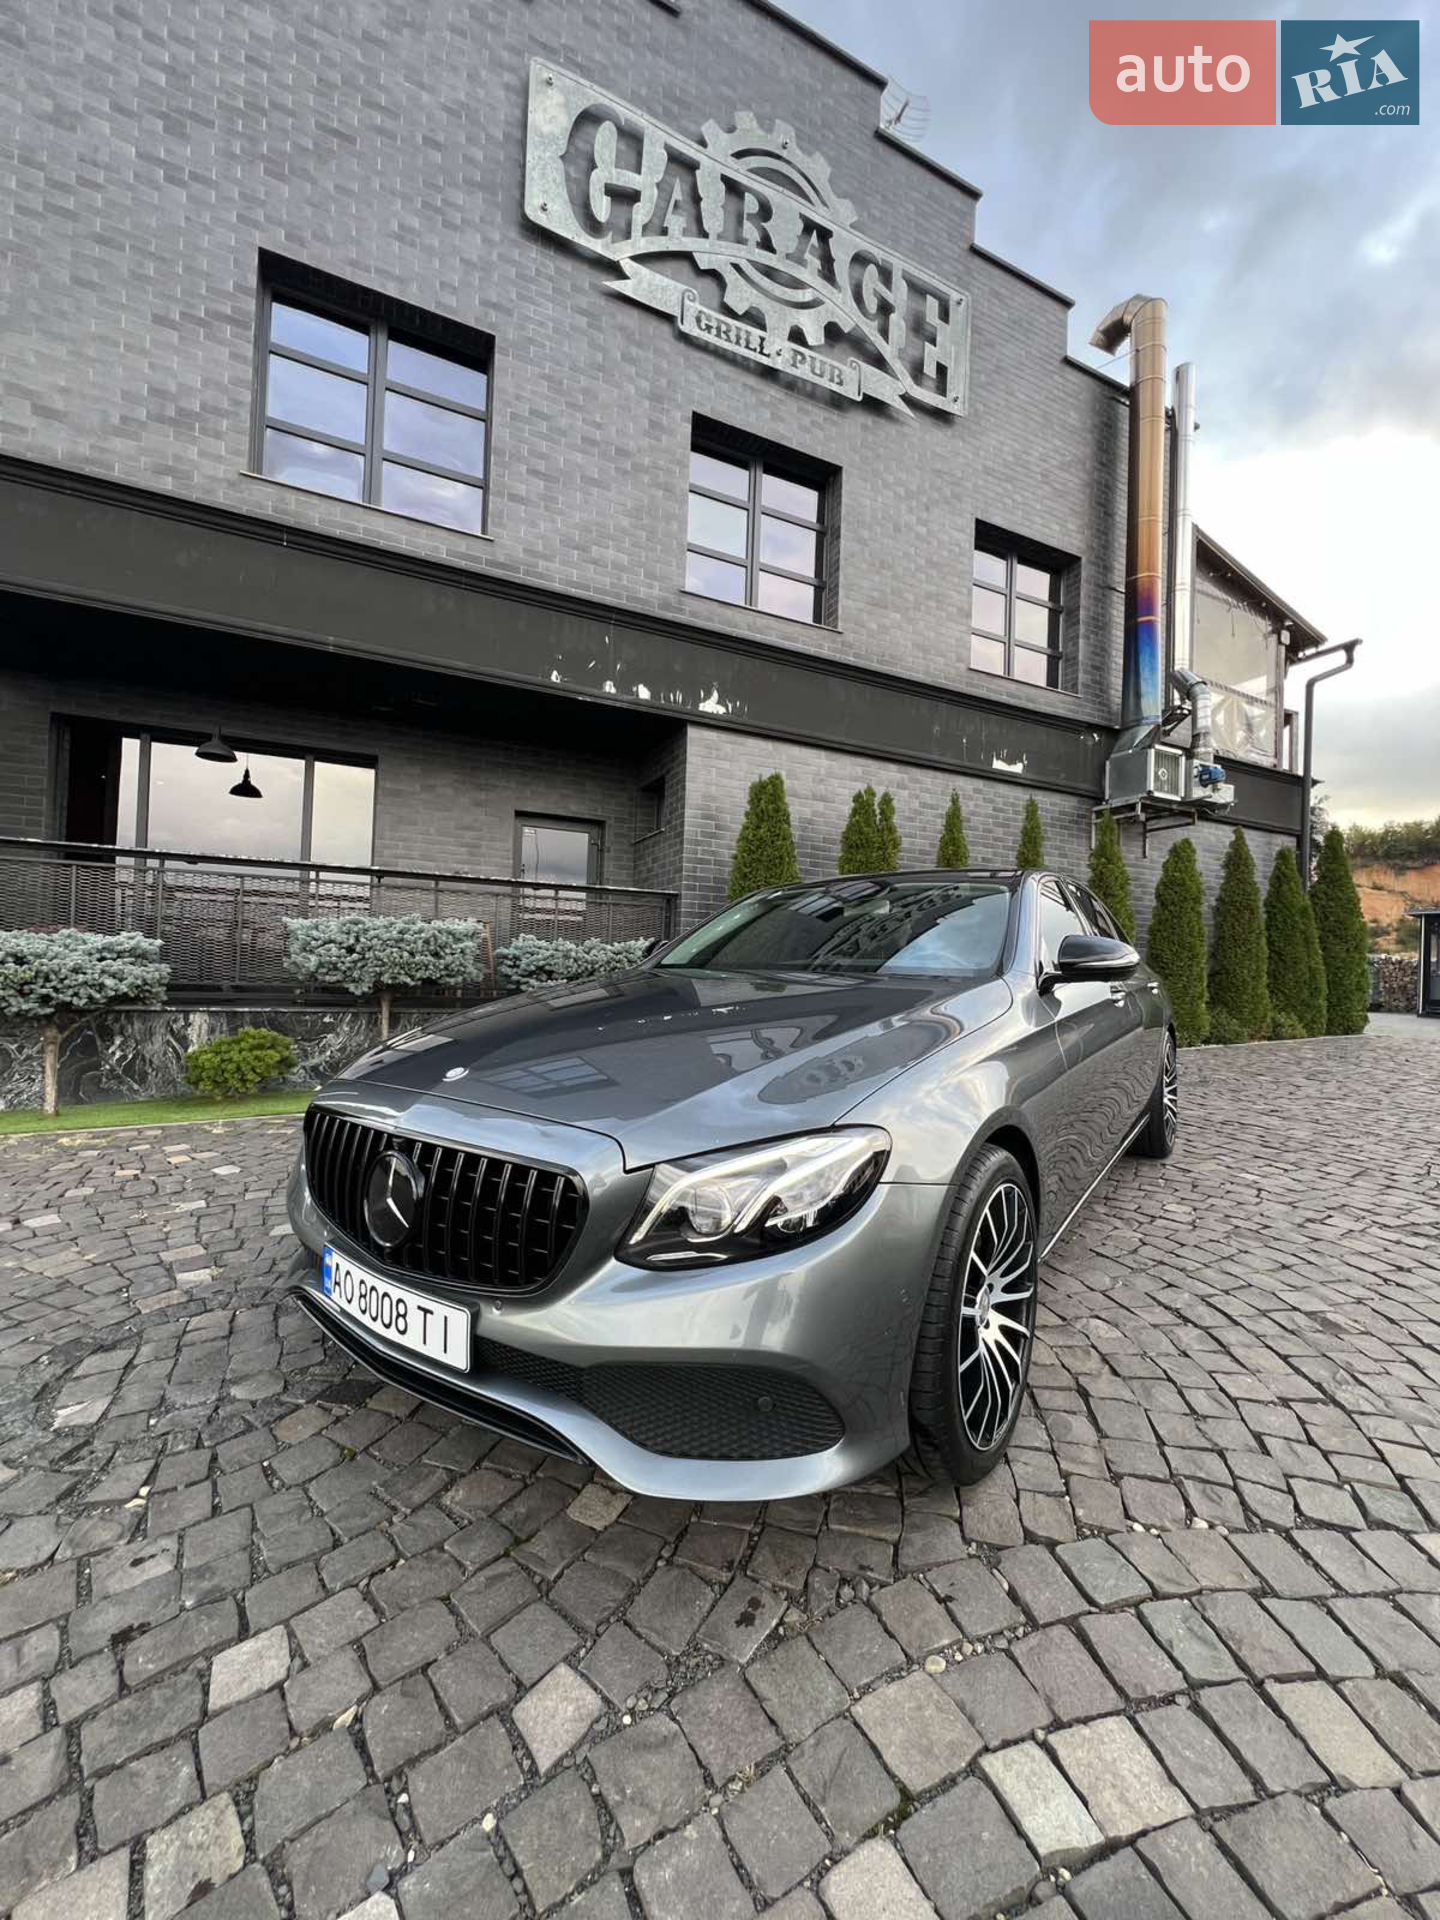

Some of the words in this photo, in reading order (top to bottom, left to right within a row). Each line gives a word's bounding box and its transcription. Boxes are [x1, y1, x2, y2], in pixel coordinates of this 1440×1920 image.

[562, 102, 951, 398] GARAGE
[694, 309, 771, 358] GRILL
[790, 347, 845, 387] PUB
[333, 1261, 354, 1305] AO
[358, 1279, 408, 1336] 8008
[416, 1305, 449, 1355] TI
